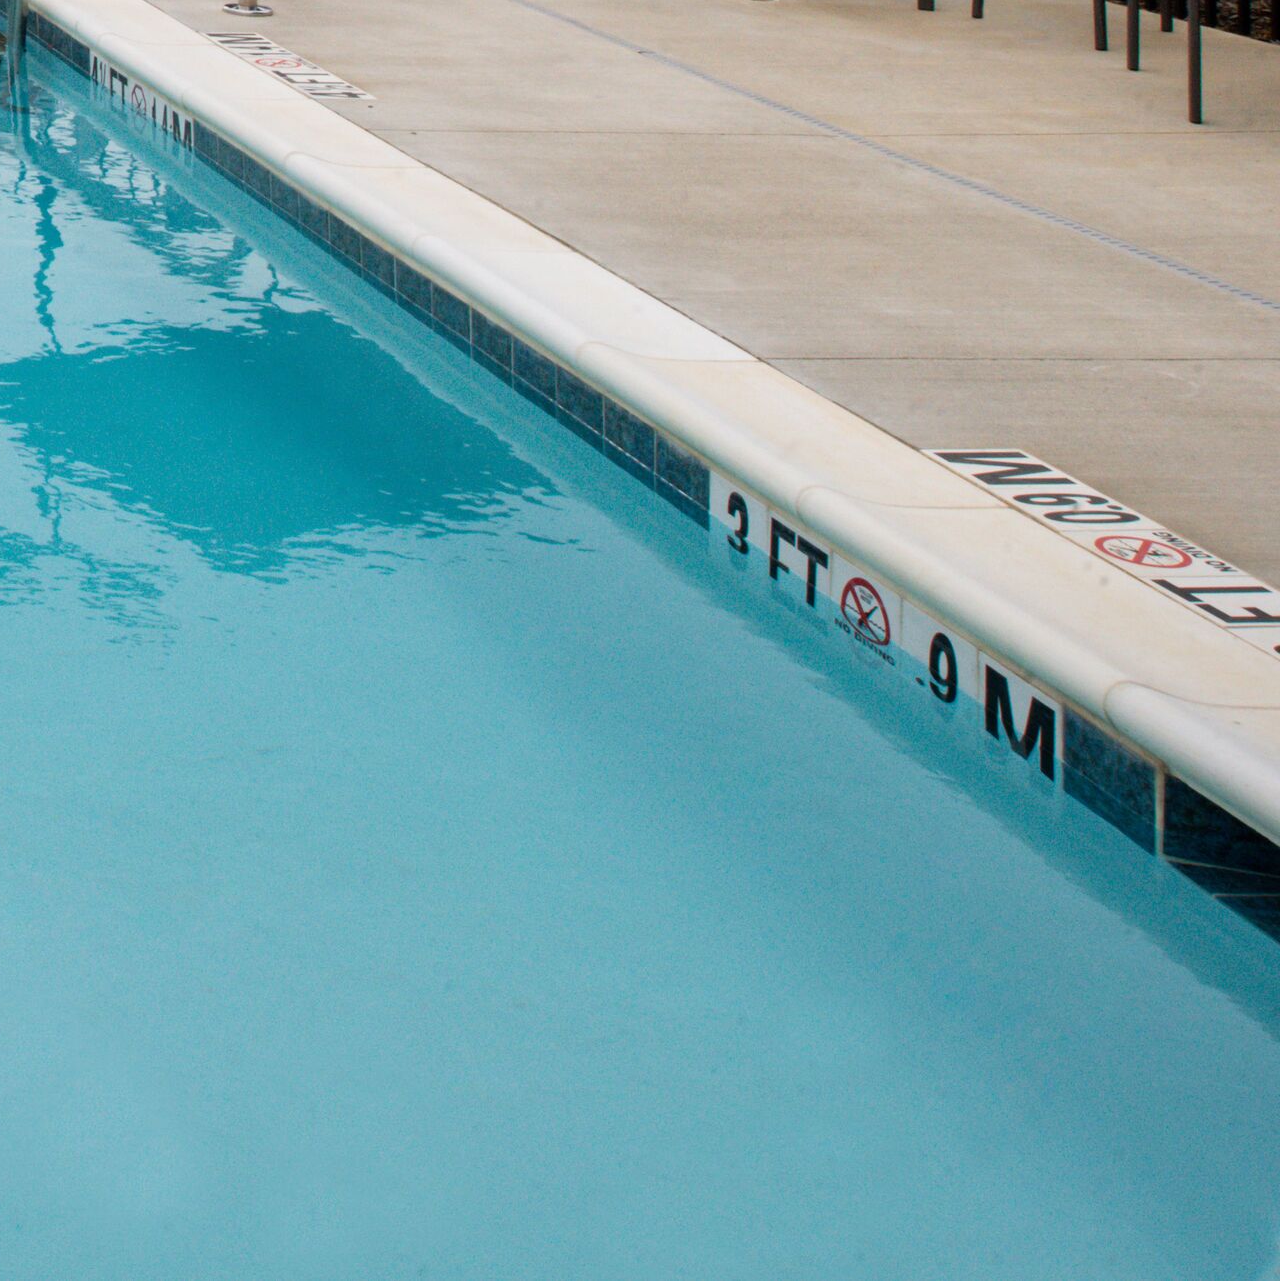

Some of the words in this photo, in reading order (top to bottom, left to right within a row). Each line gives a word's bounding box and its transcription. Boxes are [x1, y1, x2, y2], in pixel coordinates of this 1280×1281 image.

[206, 33, 272, 45] M
[110, 67, 129, 106] FT
[272, 71, 345, 84] FT
[934, 451, 1078, 486] M
[1012, 492, 1141, 524] 0.9
[1152, 531, 1213, 559] DIVING
[1204, 560, 1239, 573] NO
[726, 491, 750, 555] 3
[769, 516, 830, 608] FT
[984, 663, 1057, 782] M
